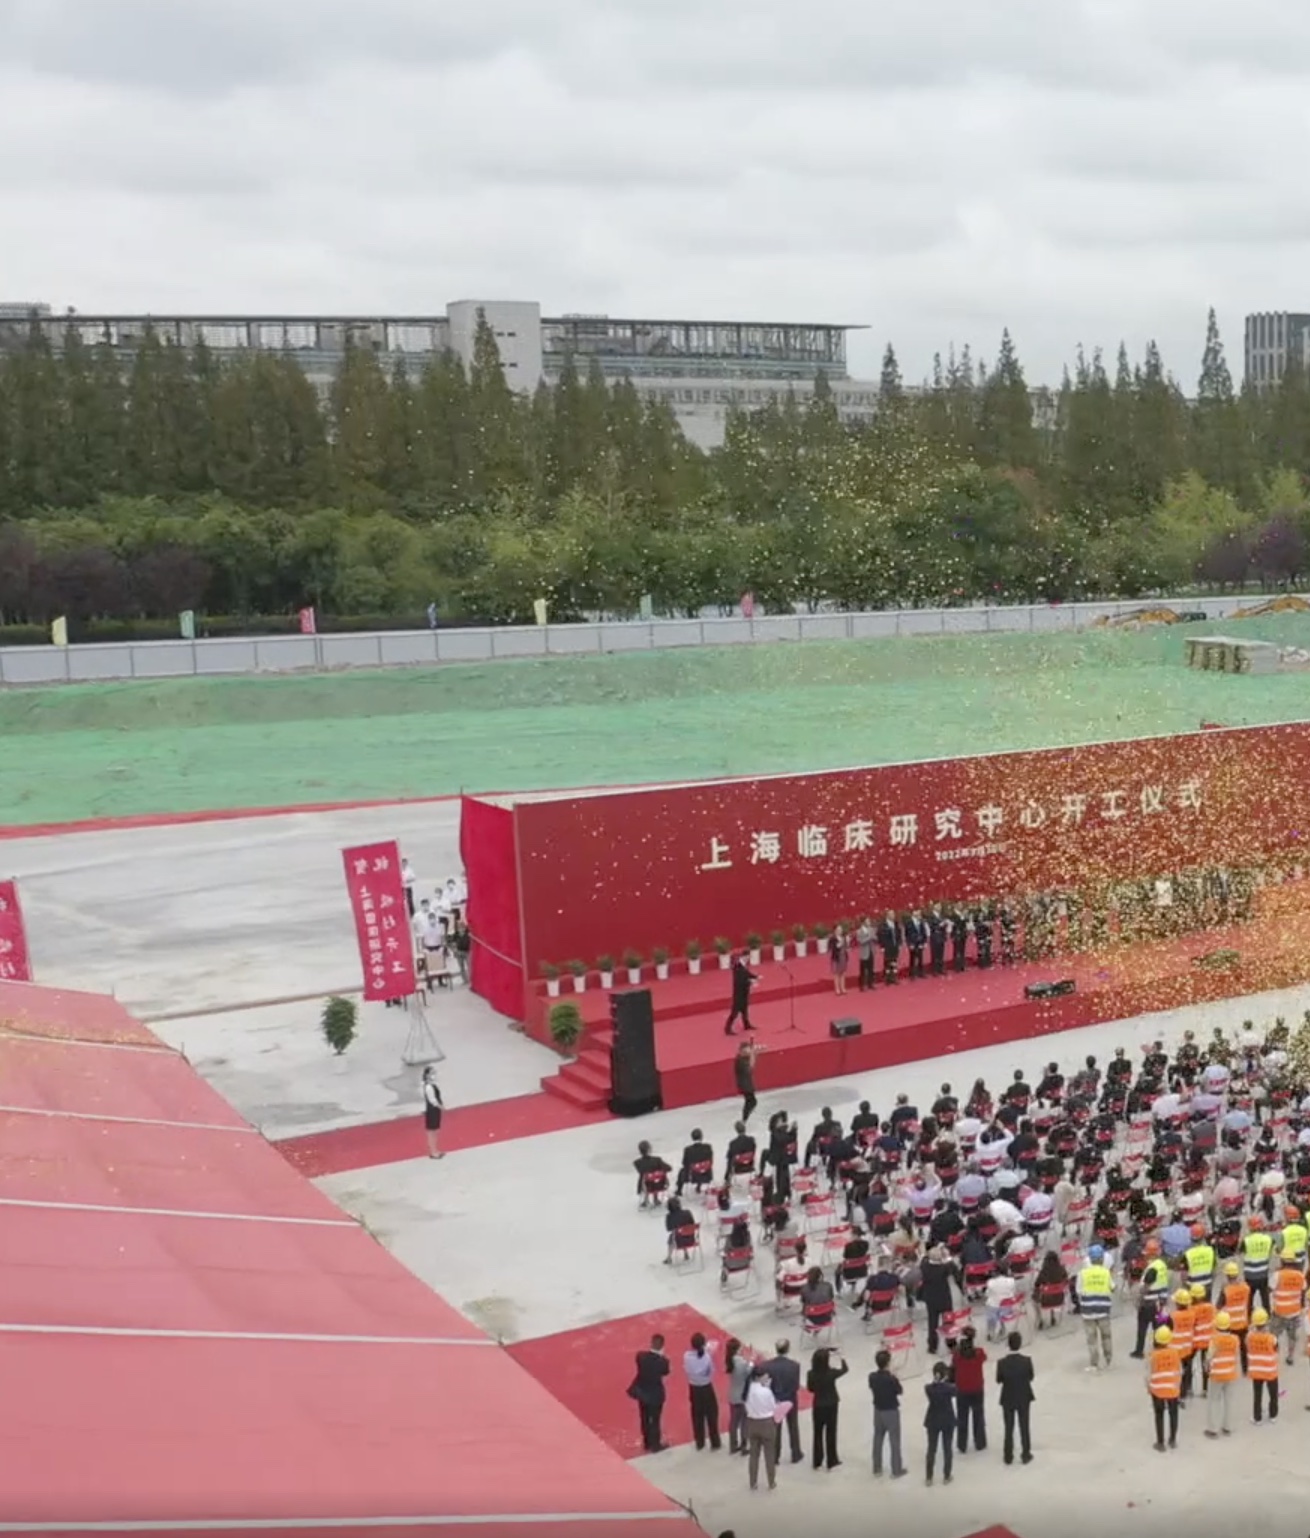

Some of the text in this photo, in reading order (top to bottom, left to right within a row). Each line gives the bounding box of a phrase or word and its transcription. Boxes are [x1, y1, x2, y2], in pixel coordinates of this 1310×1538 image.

[701, 778, 1202, 869] 上海临床研究中心开工仪式
